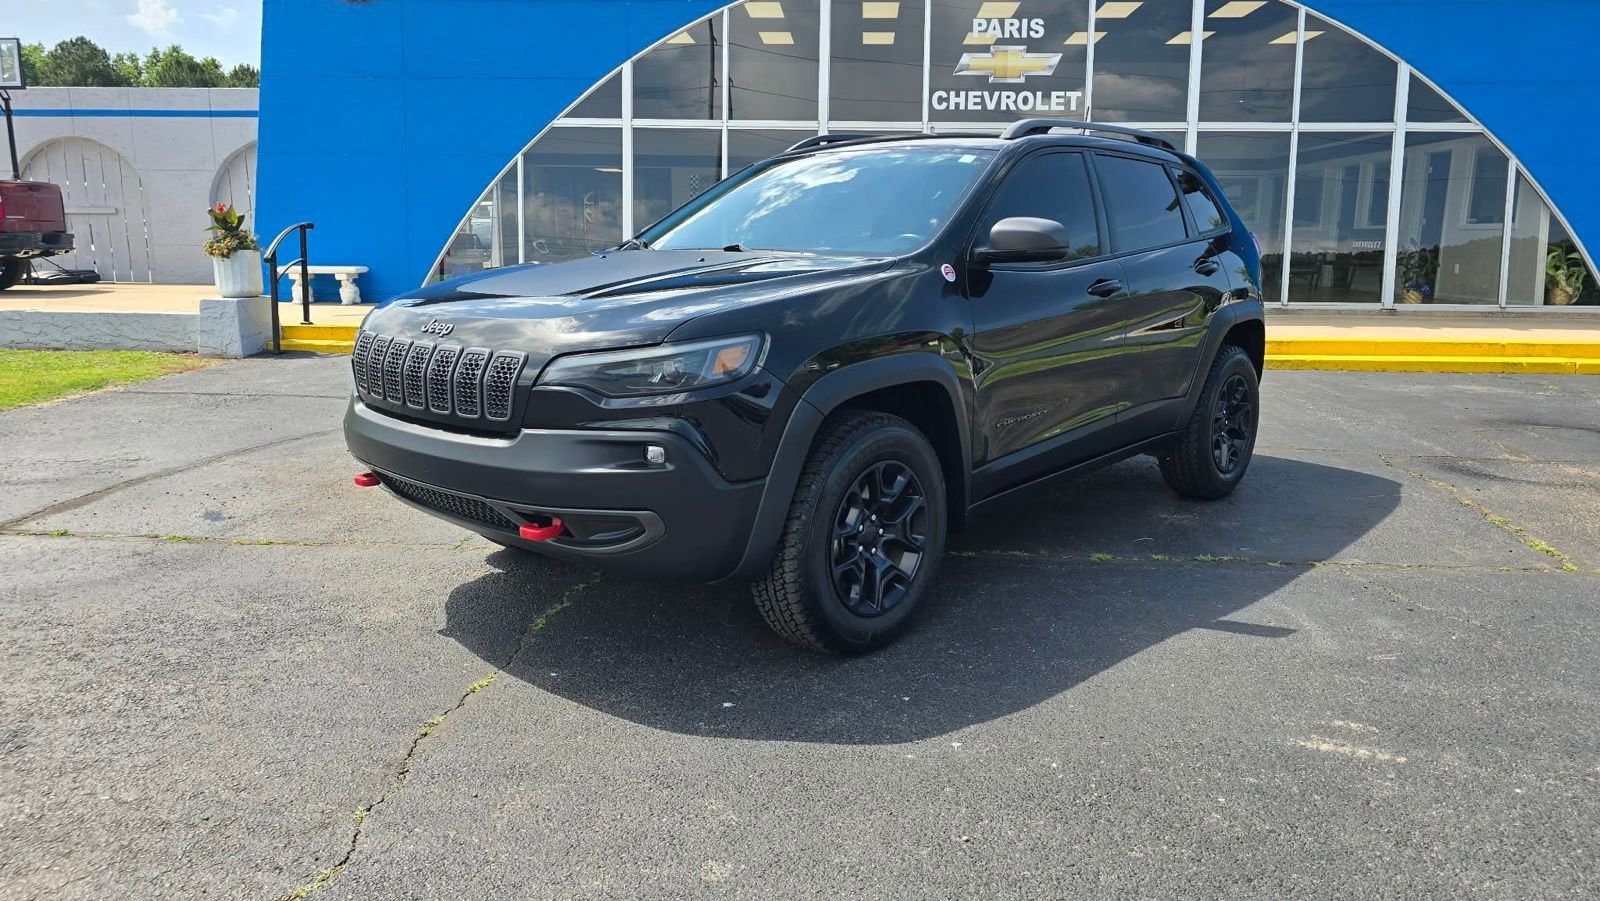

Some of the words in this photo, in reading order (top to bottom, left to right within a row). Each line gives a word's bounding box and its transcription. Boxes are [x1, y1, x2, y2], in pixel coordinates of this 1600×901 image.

[972, 18, 1045, 39] PARIS
[931, 90, 1082, 111] CHEVROLET
[421, 318, 455, 338] Jeep
